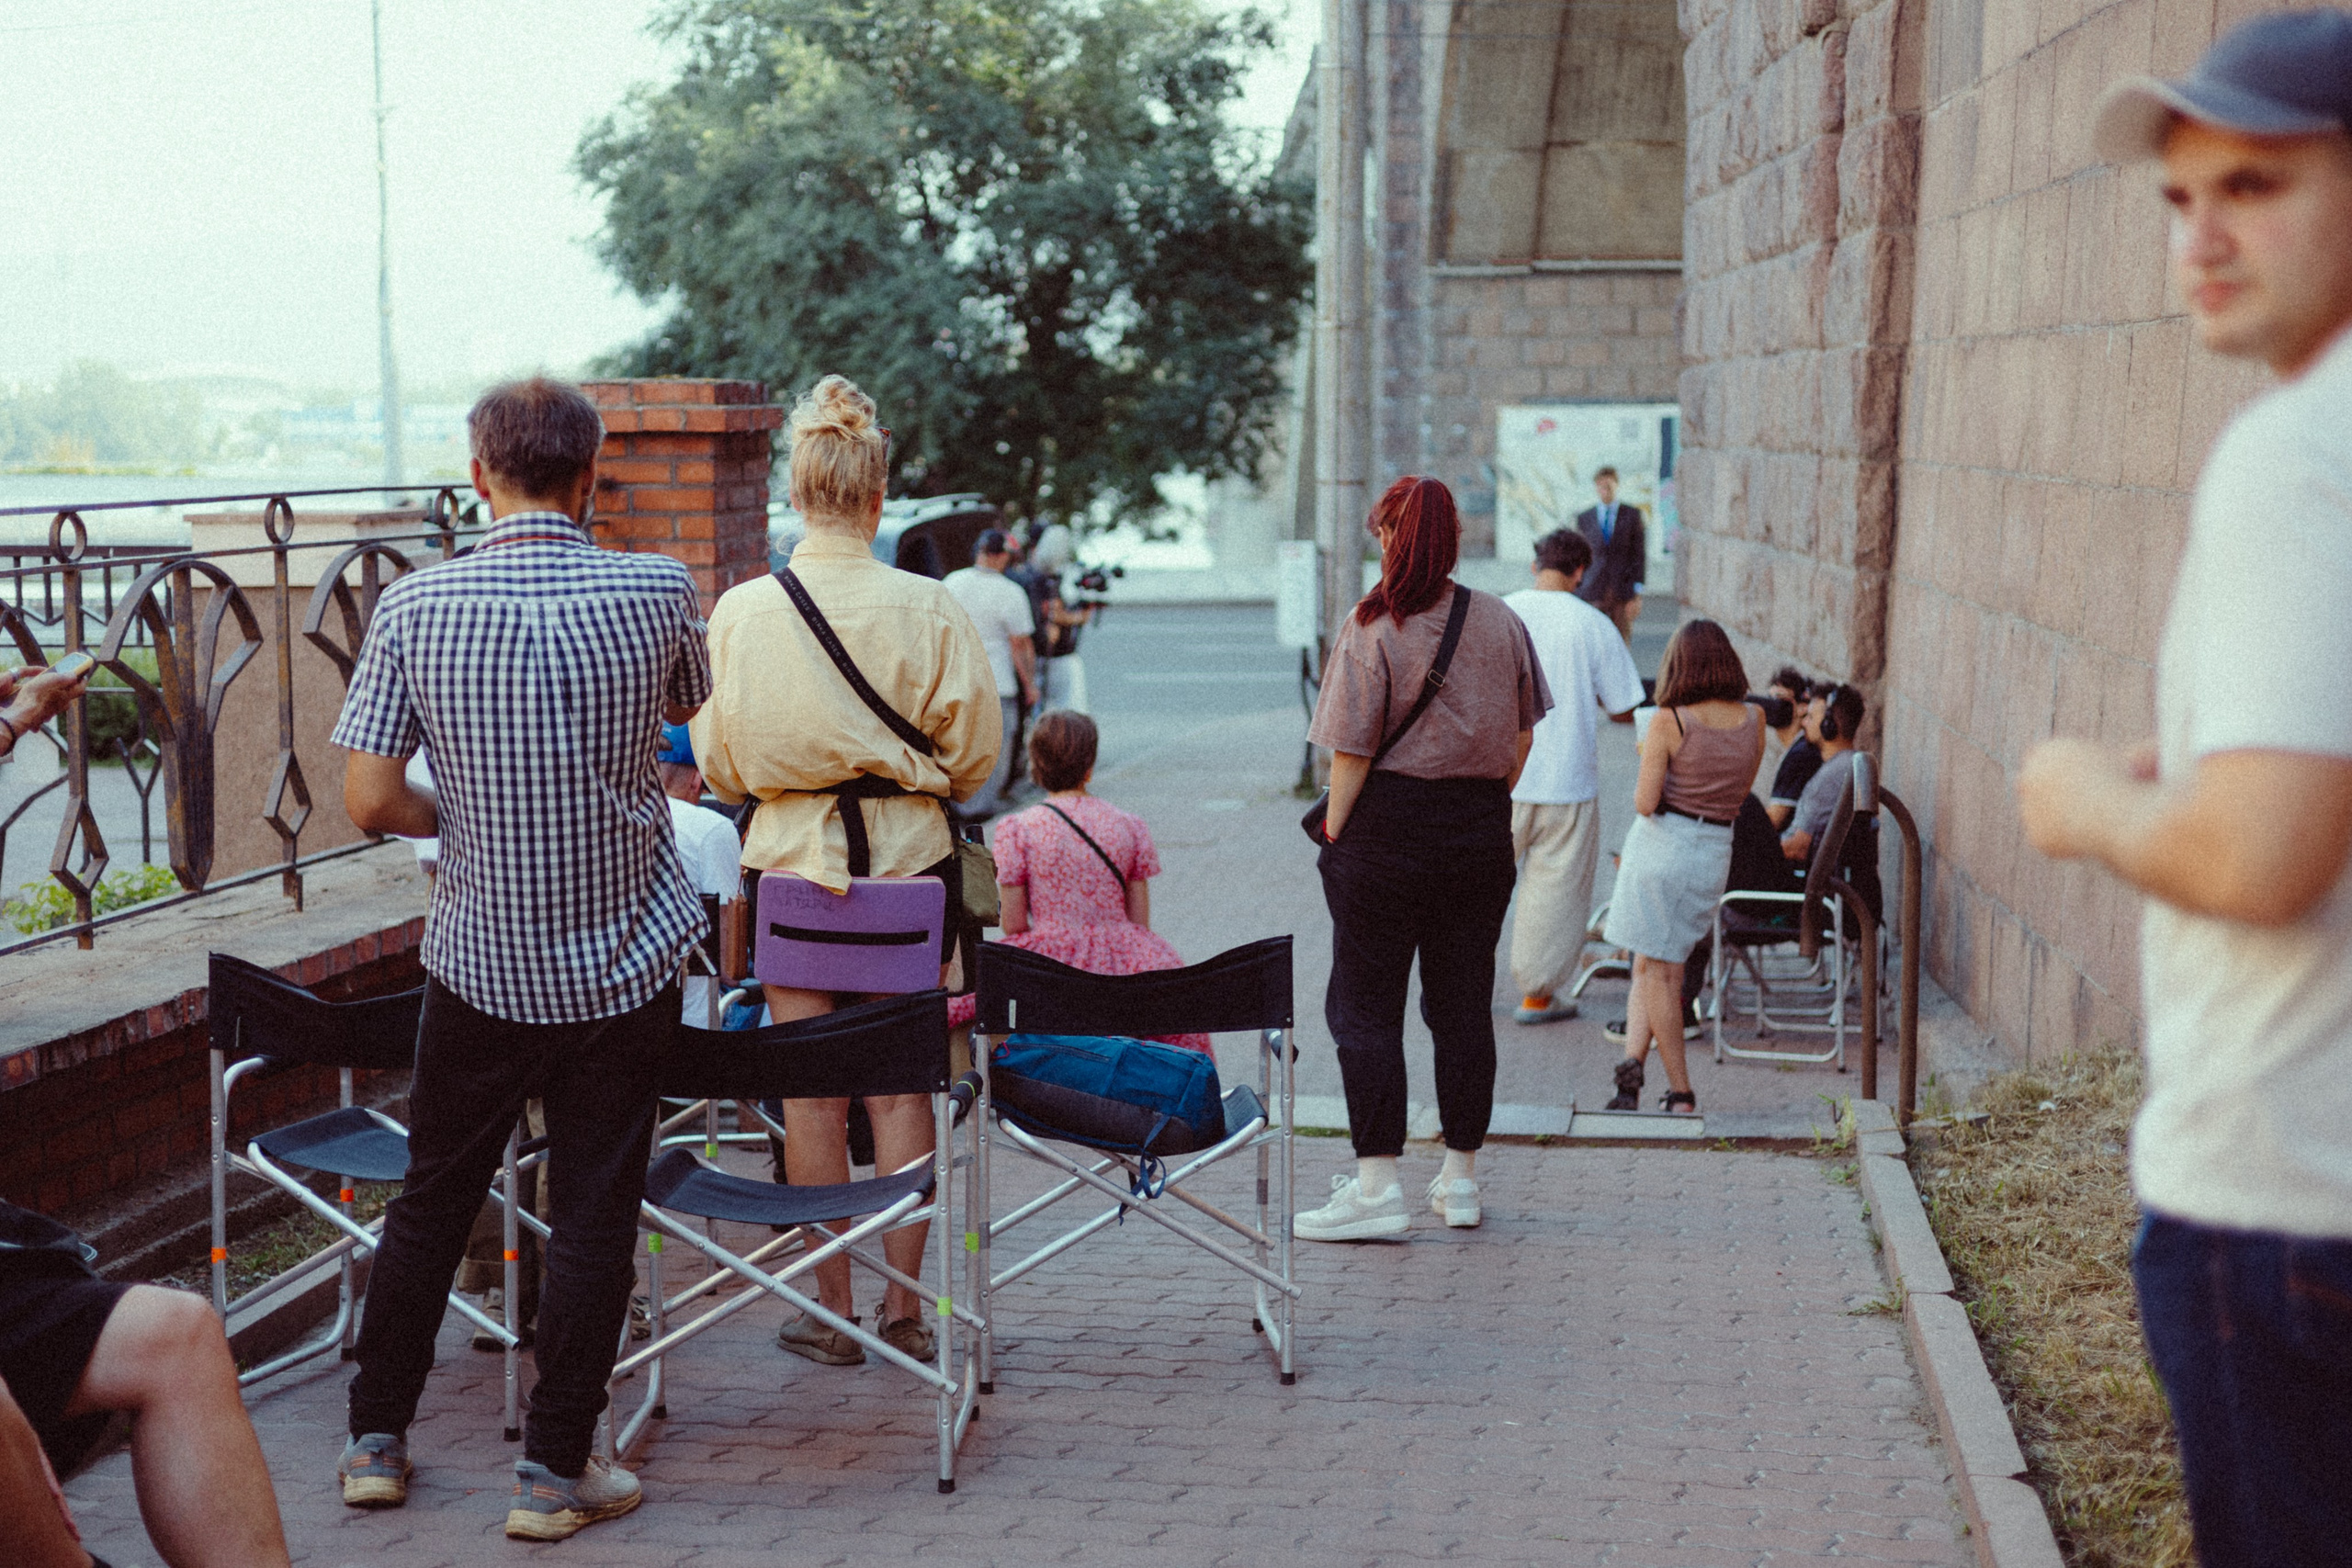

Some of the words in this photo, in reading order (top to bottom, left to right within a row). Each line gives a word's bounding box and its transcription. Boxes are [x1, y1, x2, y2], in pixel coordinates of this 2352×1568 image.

[784, 575, 797, 591] BIRKA
[796, 592, 810, 611] CASES
[811, 616, 826, 635] BIRKA
[825, 637, 842, 657] CASES
